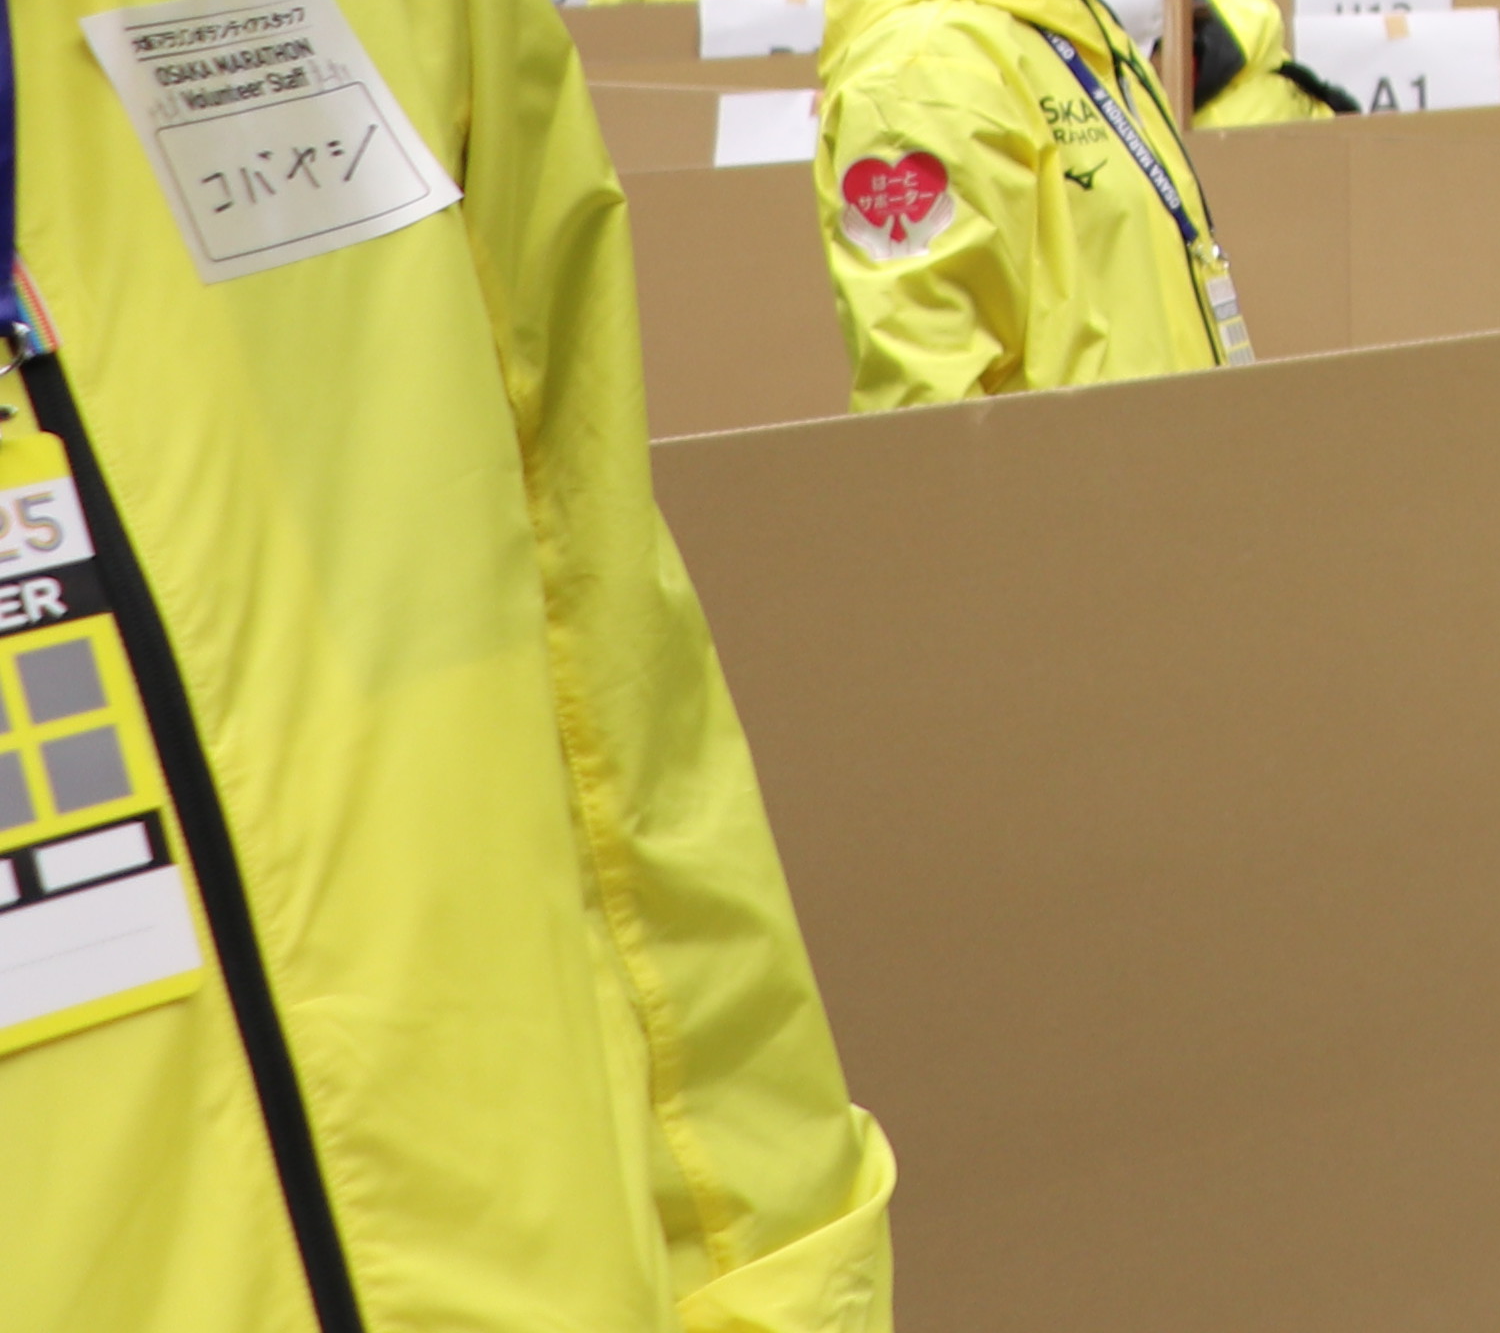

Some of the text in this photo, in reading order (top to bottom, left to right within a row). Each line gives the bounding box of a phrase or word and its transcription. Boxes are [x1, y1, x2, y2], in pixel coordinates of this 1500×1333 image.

[154, 37, 315, 87] OSAKA MARATHON
[180, 65, 307, 110] Volunteer Staff
[1371, 74, 1428, 111] A1
